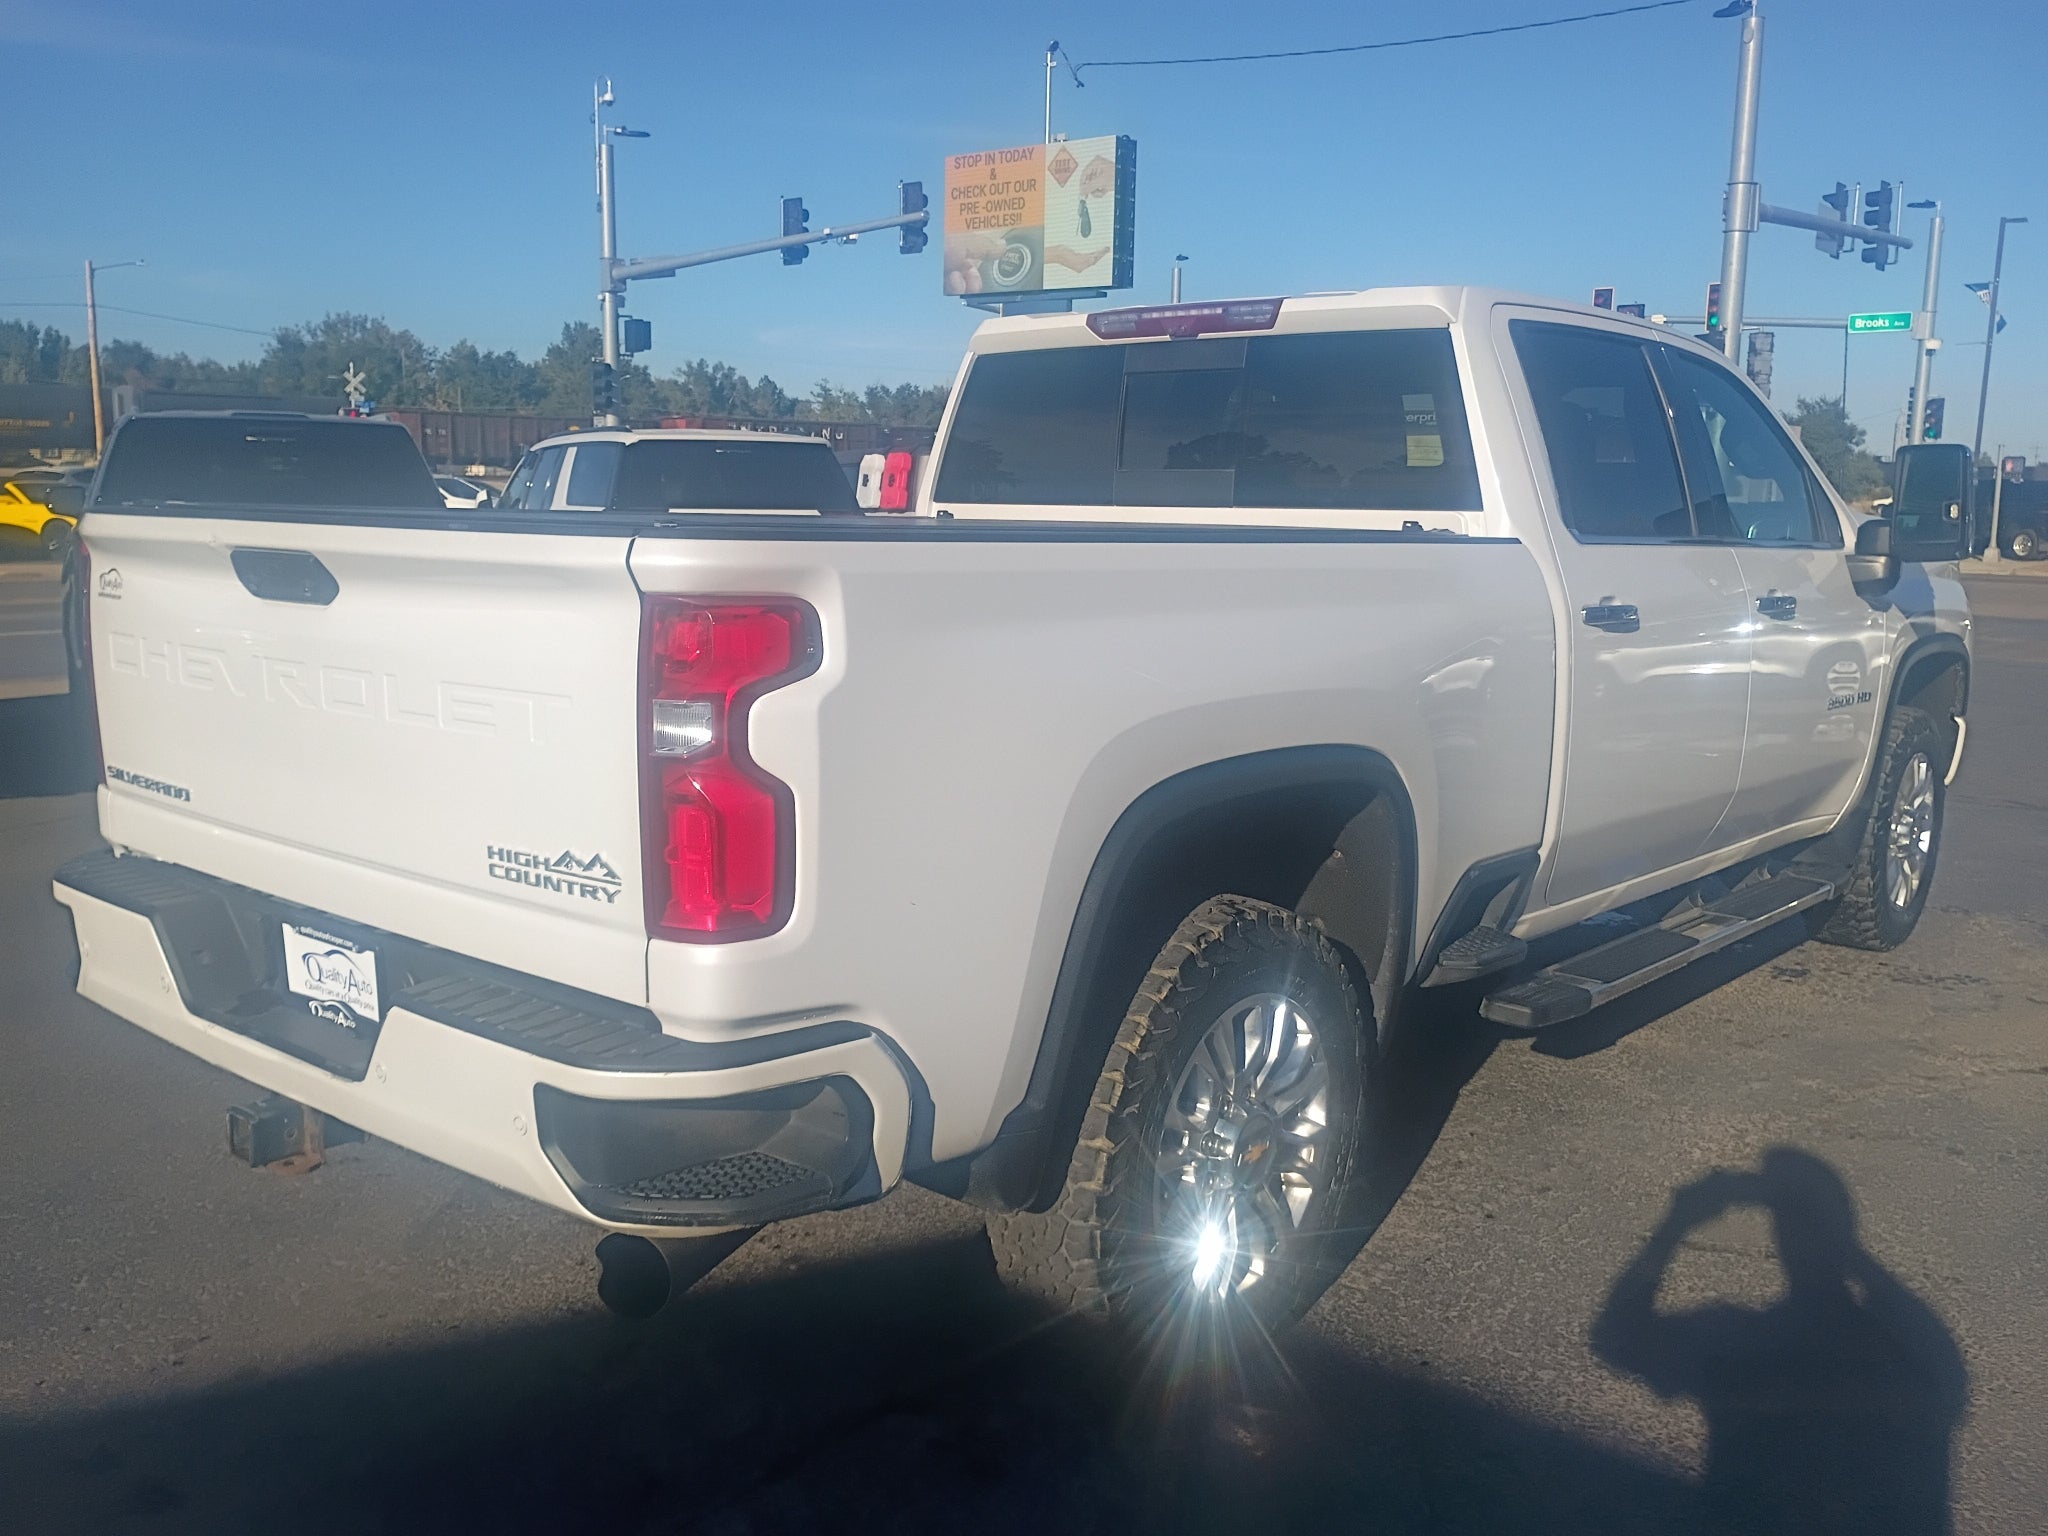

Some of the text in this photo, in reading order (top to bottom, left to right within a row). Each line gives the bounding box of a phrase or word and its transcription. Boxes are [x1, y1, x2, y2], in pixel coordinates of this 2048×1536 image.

[954, 147, 1035, 169] STOP IN TODAY
[989, 167, 997, 180] &
[951, 178, 1037, 200] CHECK OUT OUR
[965, 212, 1022, 230] VEHICLES!!
[1855, 317, 1889, 328] Brooks
[108, 631, 574, 745] CHEVROLET
[1856, 691, 1872, 704] HD
[107, 765, 191, 802] SILVERADO
[487, 845, 551, 872] HIGH
[488, 863, 622, 904] COUNTRY
